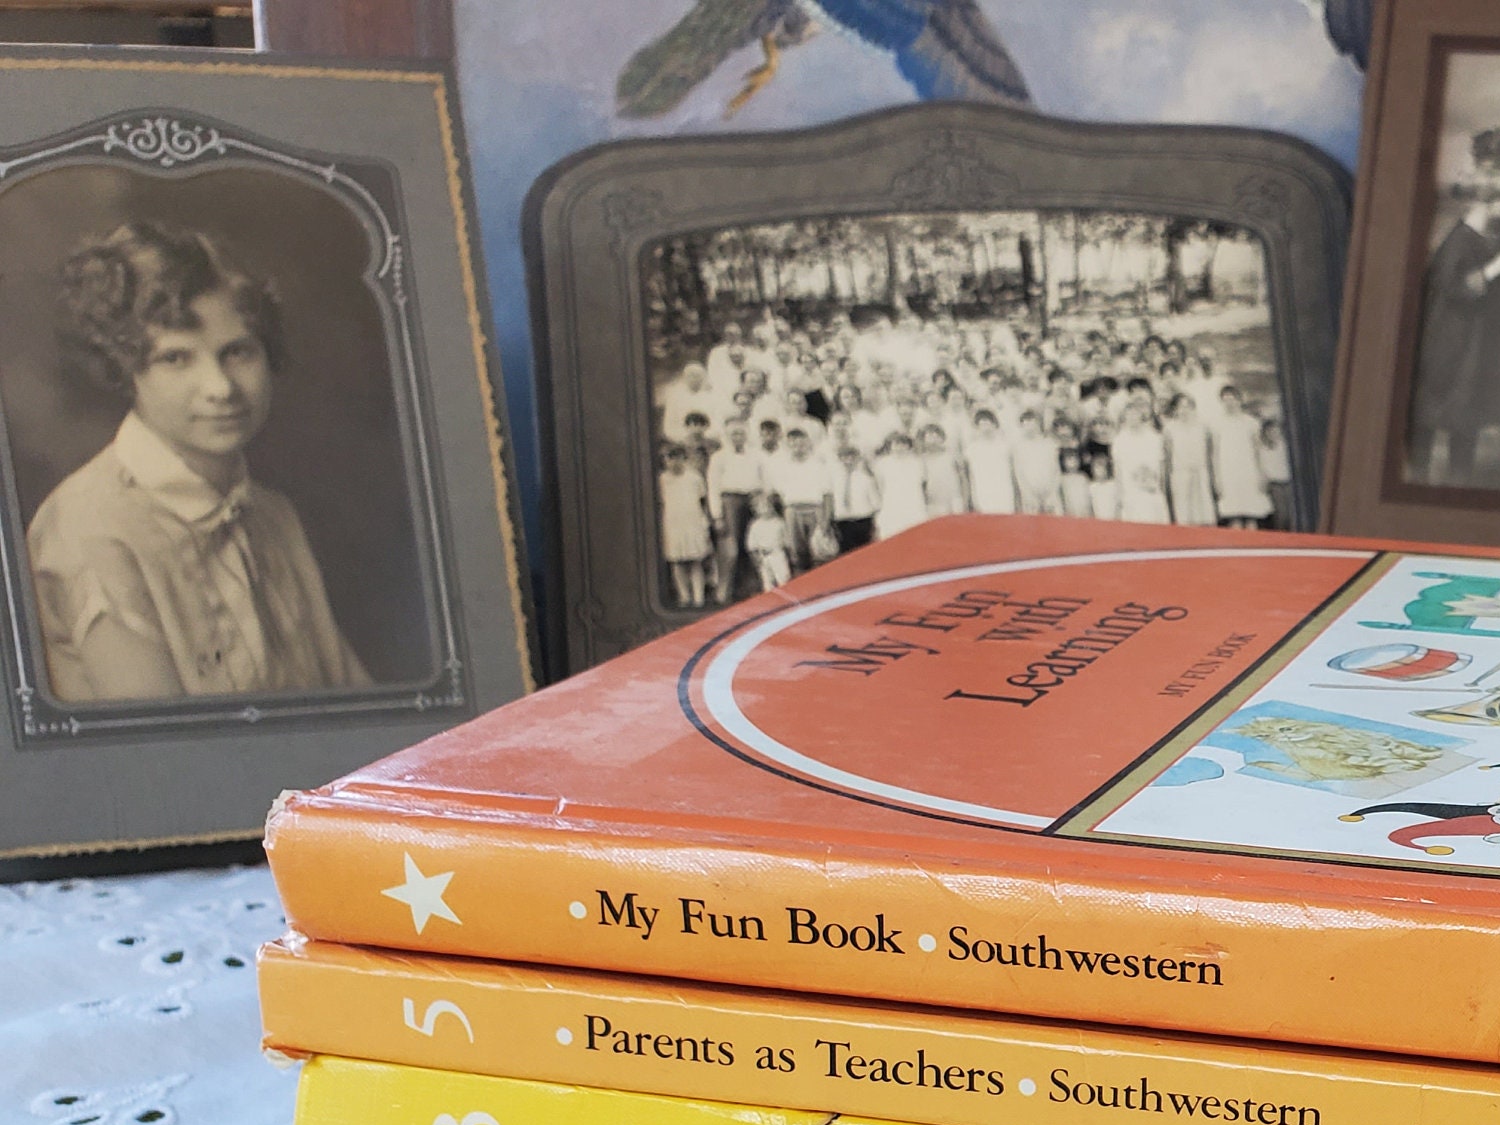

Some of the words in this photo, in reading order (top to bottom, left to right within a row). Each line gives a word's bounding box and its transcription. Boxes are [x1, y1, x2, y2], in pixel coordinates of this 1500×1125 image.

[794, 637, 940, 676] My
[876, 590, 1015, 632] Fun
[944, 602, 1188, 707] Learning
[976, 597, 1092, 641] with
[1157, 681, 1196, 697] MY
[1180, 660, 1224, 680] FUN
[1207, 632, 1257, 658] BOOK
[596, 890, 659, 939] My
[680, 897, 767, 942] Fun
[788, 907, 905, 955] Book
[948, 925, 1224, 986] Southwestern
[403, 998, 475, 1044] 5
[584, 1014, 734, 1066] Parents
[755, 1043, 796, 1074] as
[815, 1039, 1006, 1096] Teachers
